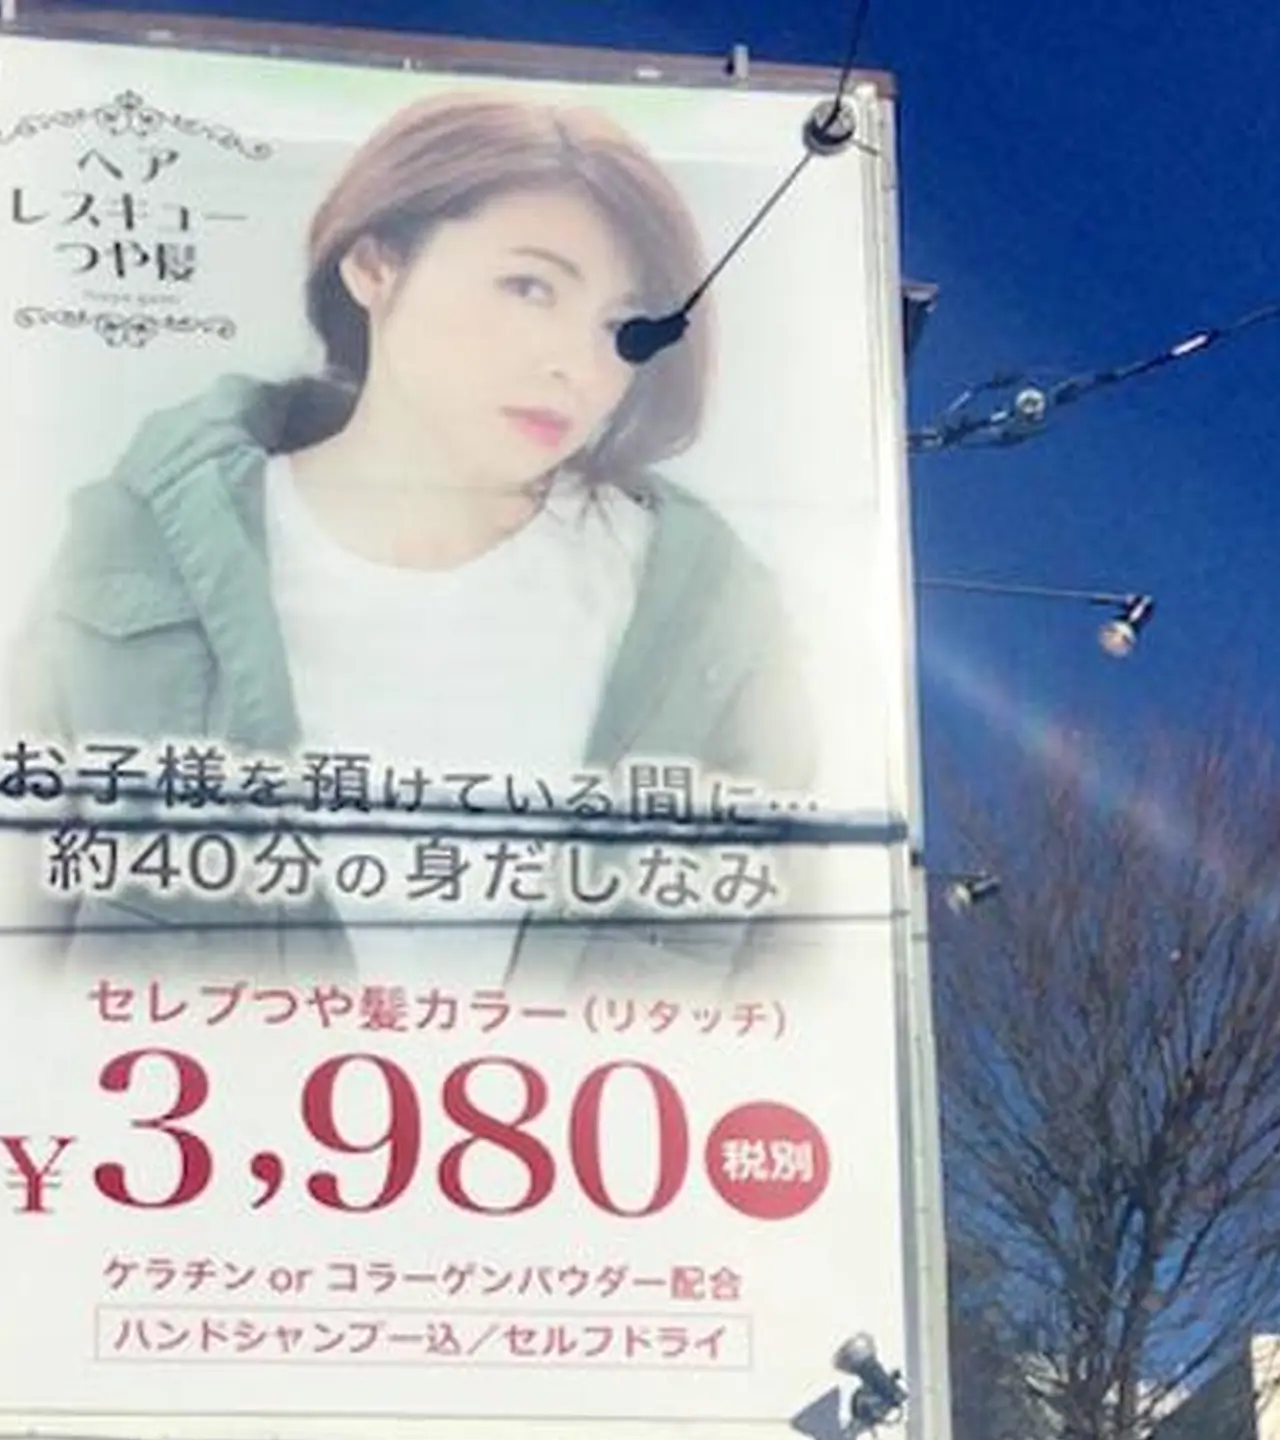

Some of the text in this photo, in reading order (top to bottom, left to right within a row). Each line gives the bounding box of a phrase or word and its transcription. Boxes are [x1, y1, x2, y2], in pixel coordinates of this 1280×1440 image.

[77, 147, 179, 183] ヘア
[11, 186, 249, 232] レスキュー
[47, 822, 778, 909] 約40分の身だしなみ
[721, 1138, 815, 1184] 税別
